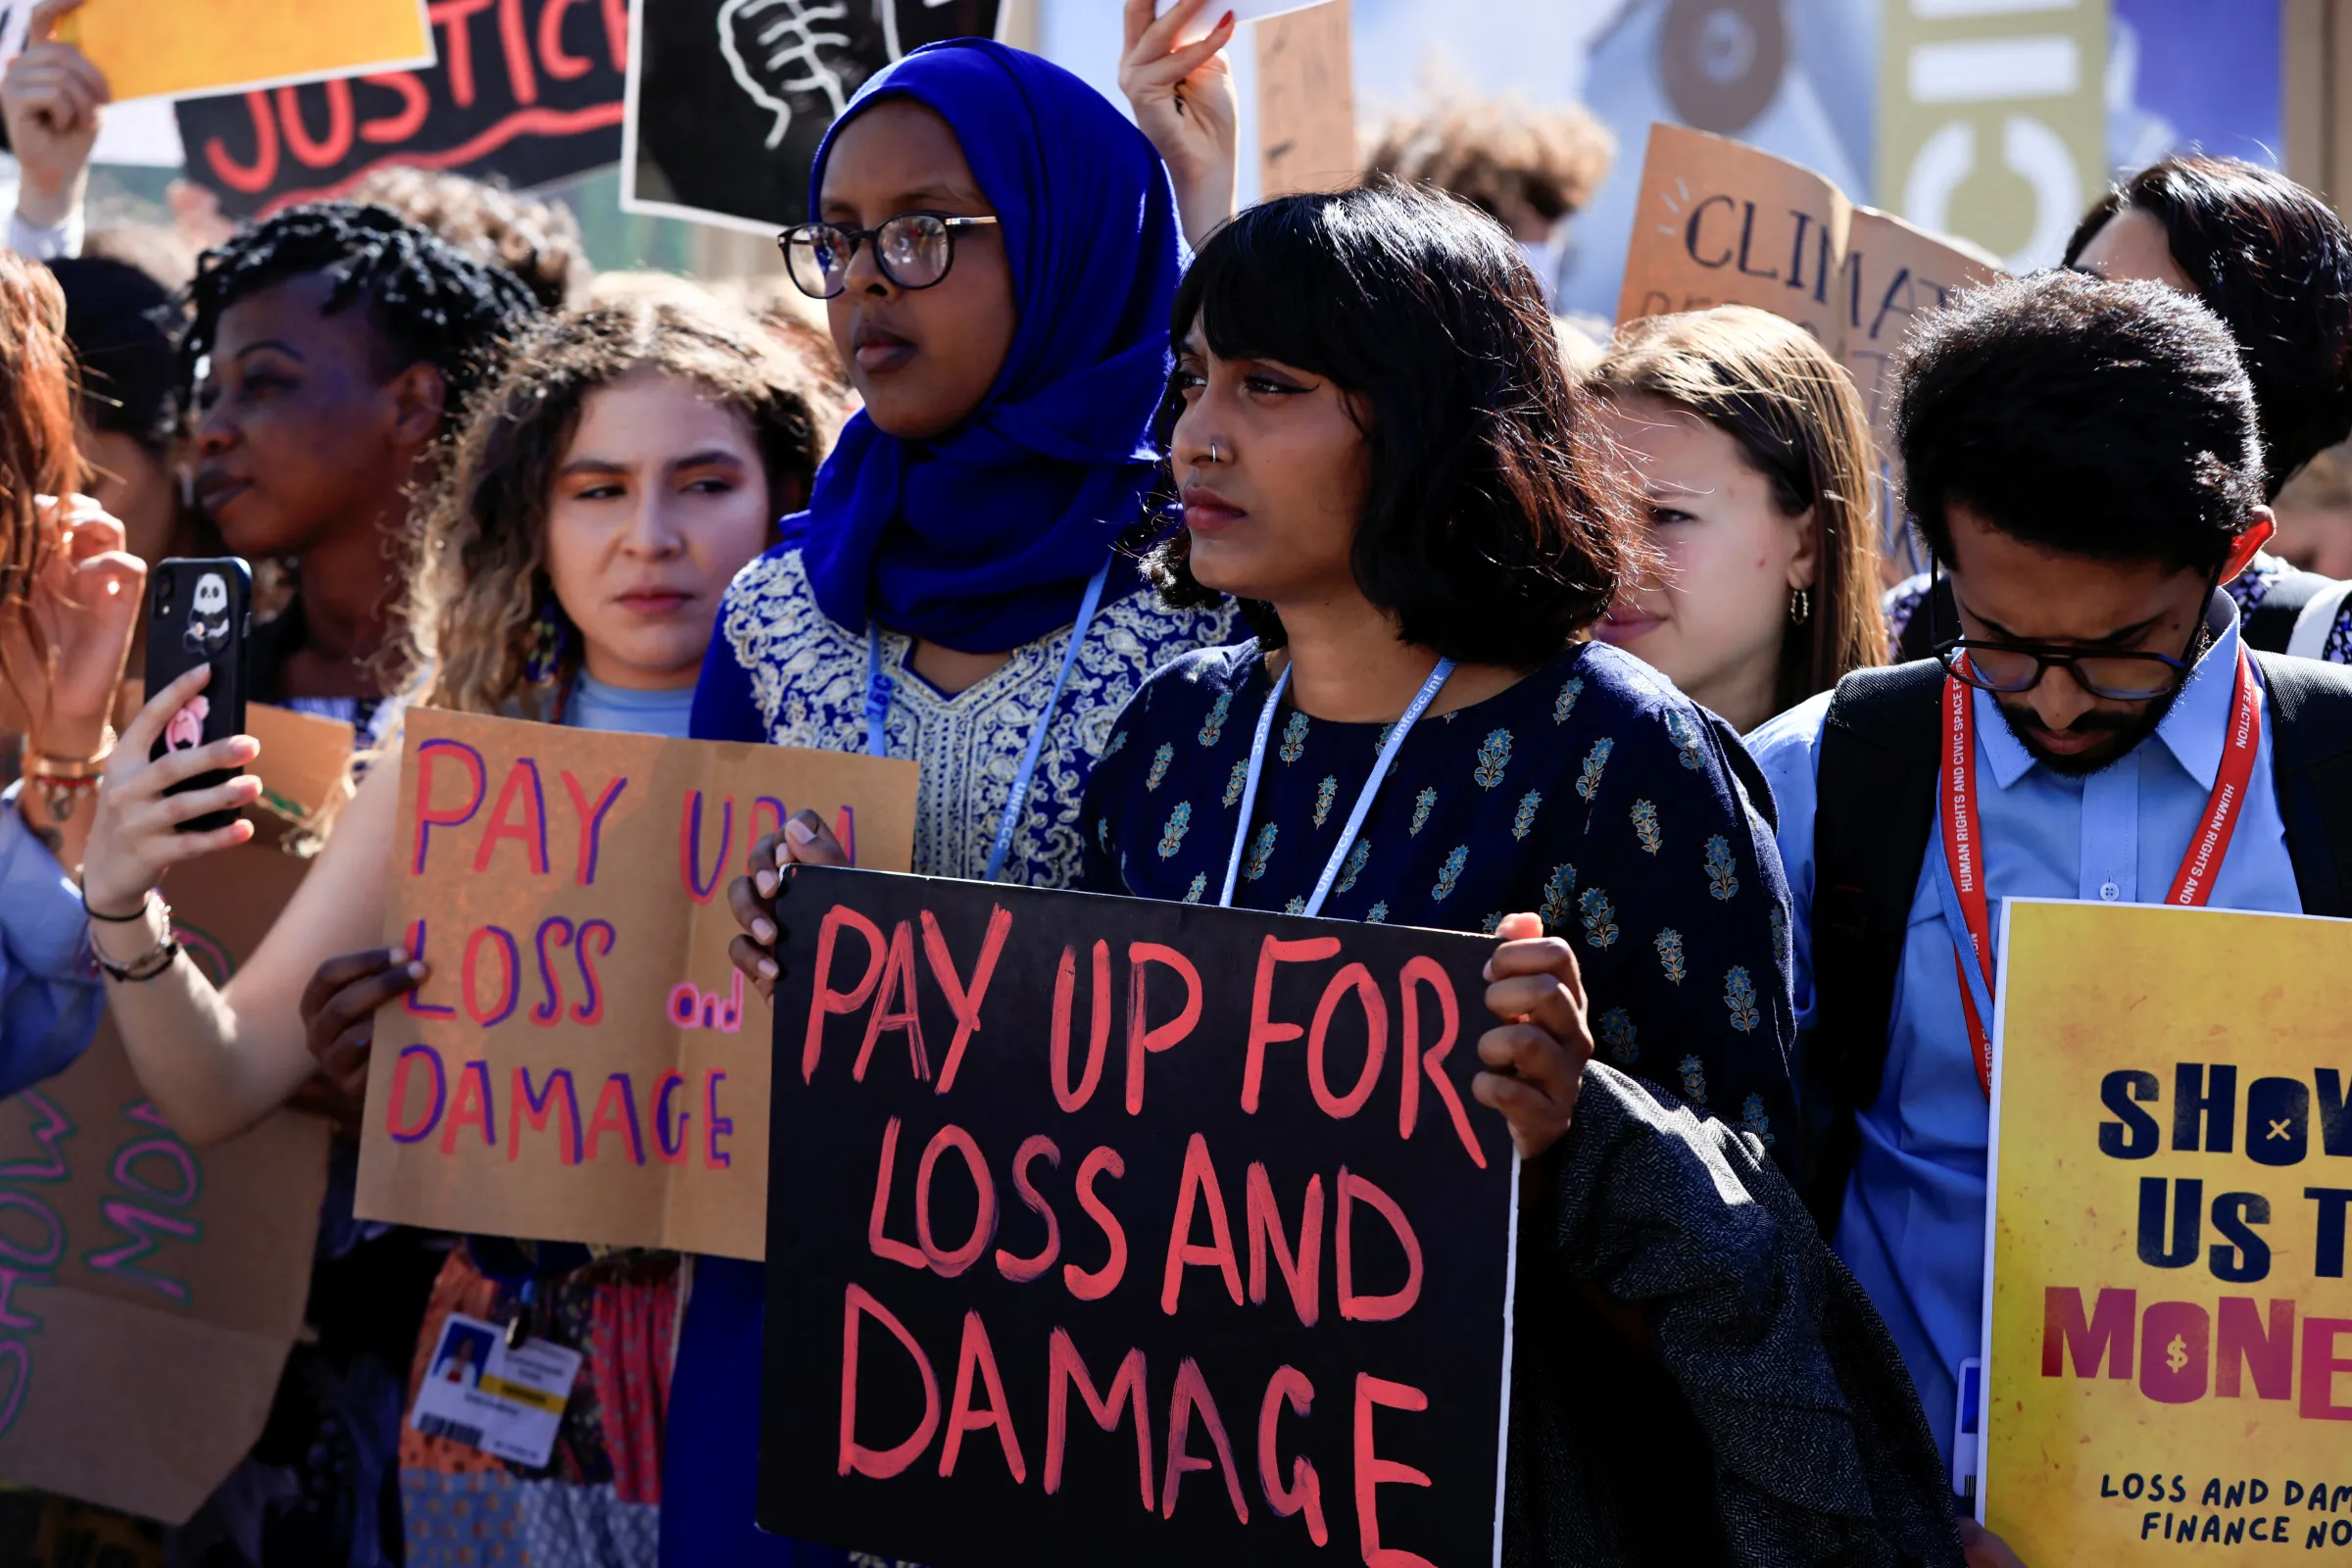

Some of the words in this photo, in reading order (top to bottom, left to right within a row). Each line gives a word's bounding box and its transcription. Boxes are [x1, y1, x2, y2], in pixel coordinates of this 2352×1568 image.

[1251, 691, 1278, 756] UNFCCC
[1952, 691, 1964, 731] SPACE
[2235, 704, 2251, 749] ACTION
[1953, 736, 1964, 765] CIVIC
[1953, 766, 1965, 793] AND
[2210, 783, 2235, 832] HUMAN
[411, 738, 628, 887] PAY
[997, 781, 1027, 850] UNFCCC
[1954, 795, 1969, 842] RIGHTS
[1315, 824, 1355, 893] UNFCCC
[1957, 844, 1974, 893] HUMAN
[2190, 829, 2219, 878] RIGHTS
[2179, 877, 2199, 906] AND
[400, 915, 616, 1028] LOSS
[667, 965, 744, 1034] and
[802, 903, 1015, 1094] PAY
[1050, 938, 1204, 1117] UP
[1240, 934, 1488, 1170] FOR
[385, 1043, 733, 1171] DAMAGE
[868, 1114, 1129, 1301] LOSS
[1160, 1131, 1425, 1328] AND
[2136, 1176, 2272, 1284] US
[2041, 1286, 2352, 1423] MONE
[837, 1282, 1438, 1568] DAMAGE
[2100, 1473, 2186, 1503] LOSS
[2201, 1478, 2269, 1509] AND
[2140, 1511, 2290, 1545] FINANCE
[2305, 1519, 2352, 1549] NO
